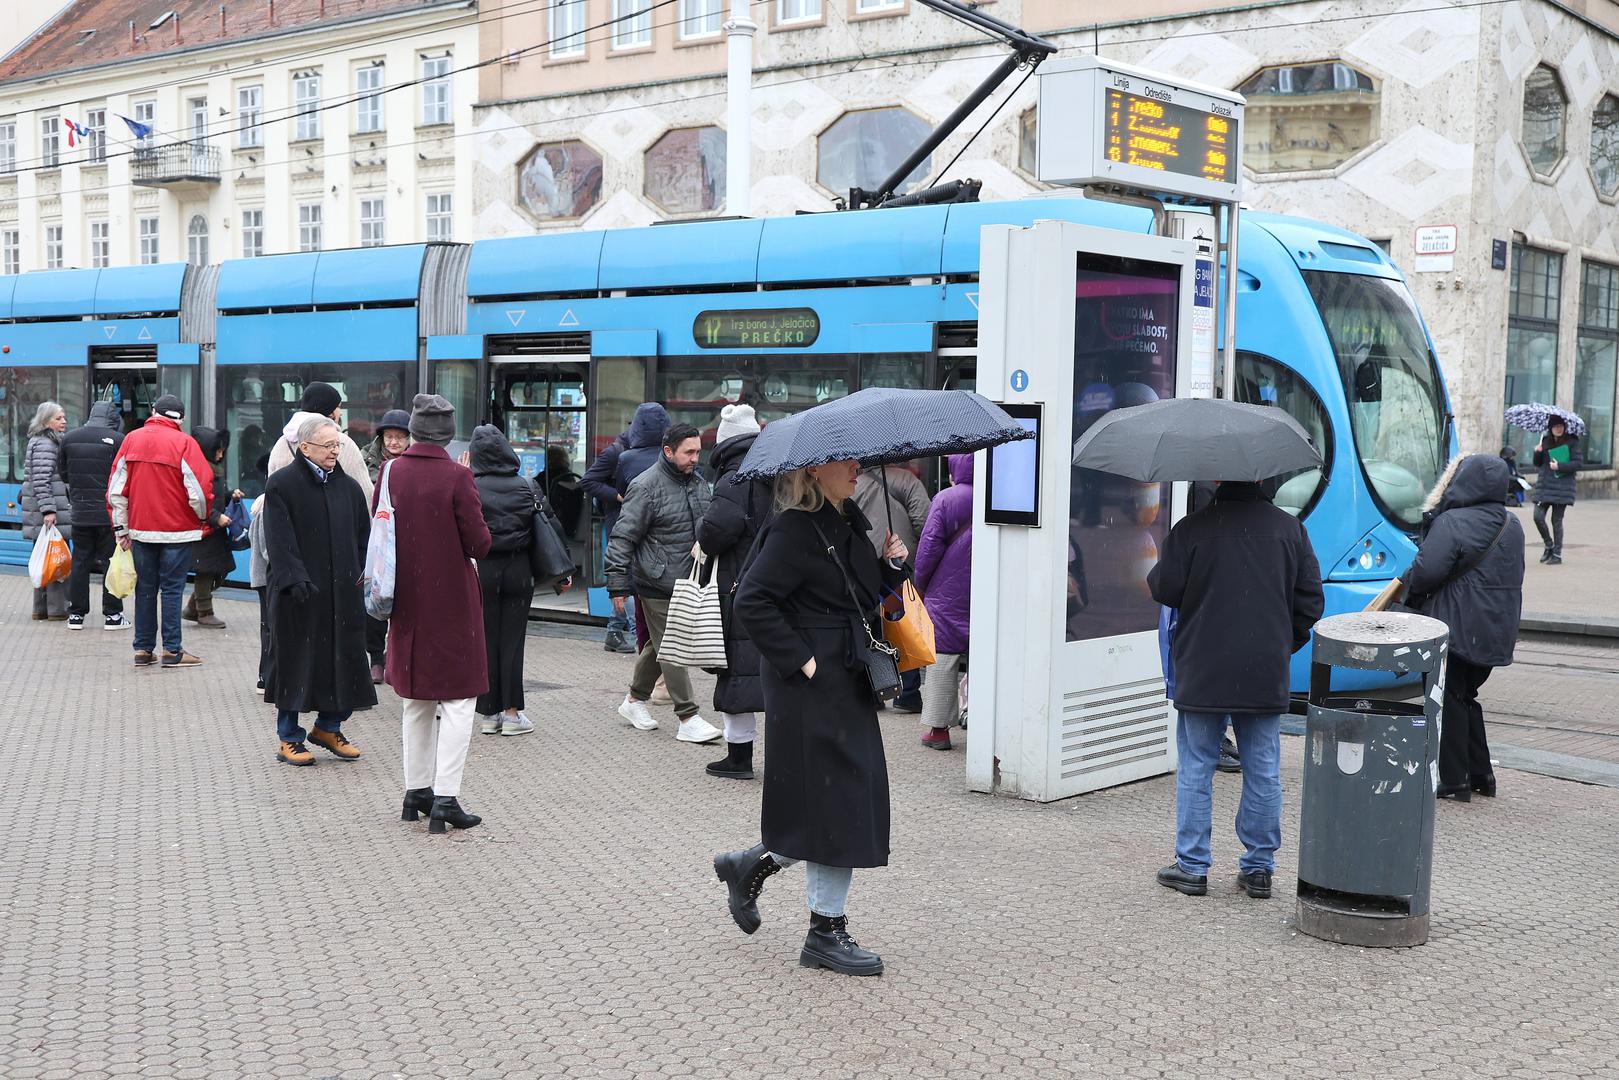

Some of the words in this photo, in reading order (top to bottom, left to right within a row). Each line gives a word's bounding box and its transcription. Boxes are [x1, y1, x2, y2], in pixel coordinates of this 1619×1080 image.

[1113, 76, 1130, 91] Linija
[1144, 86, 1172, 102] Odredište
[1211, 103, 1232, 117] Dolazak
[741, 329, 804, 343] PREČKO
